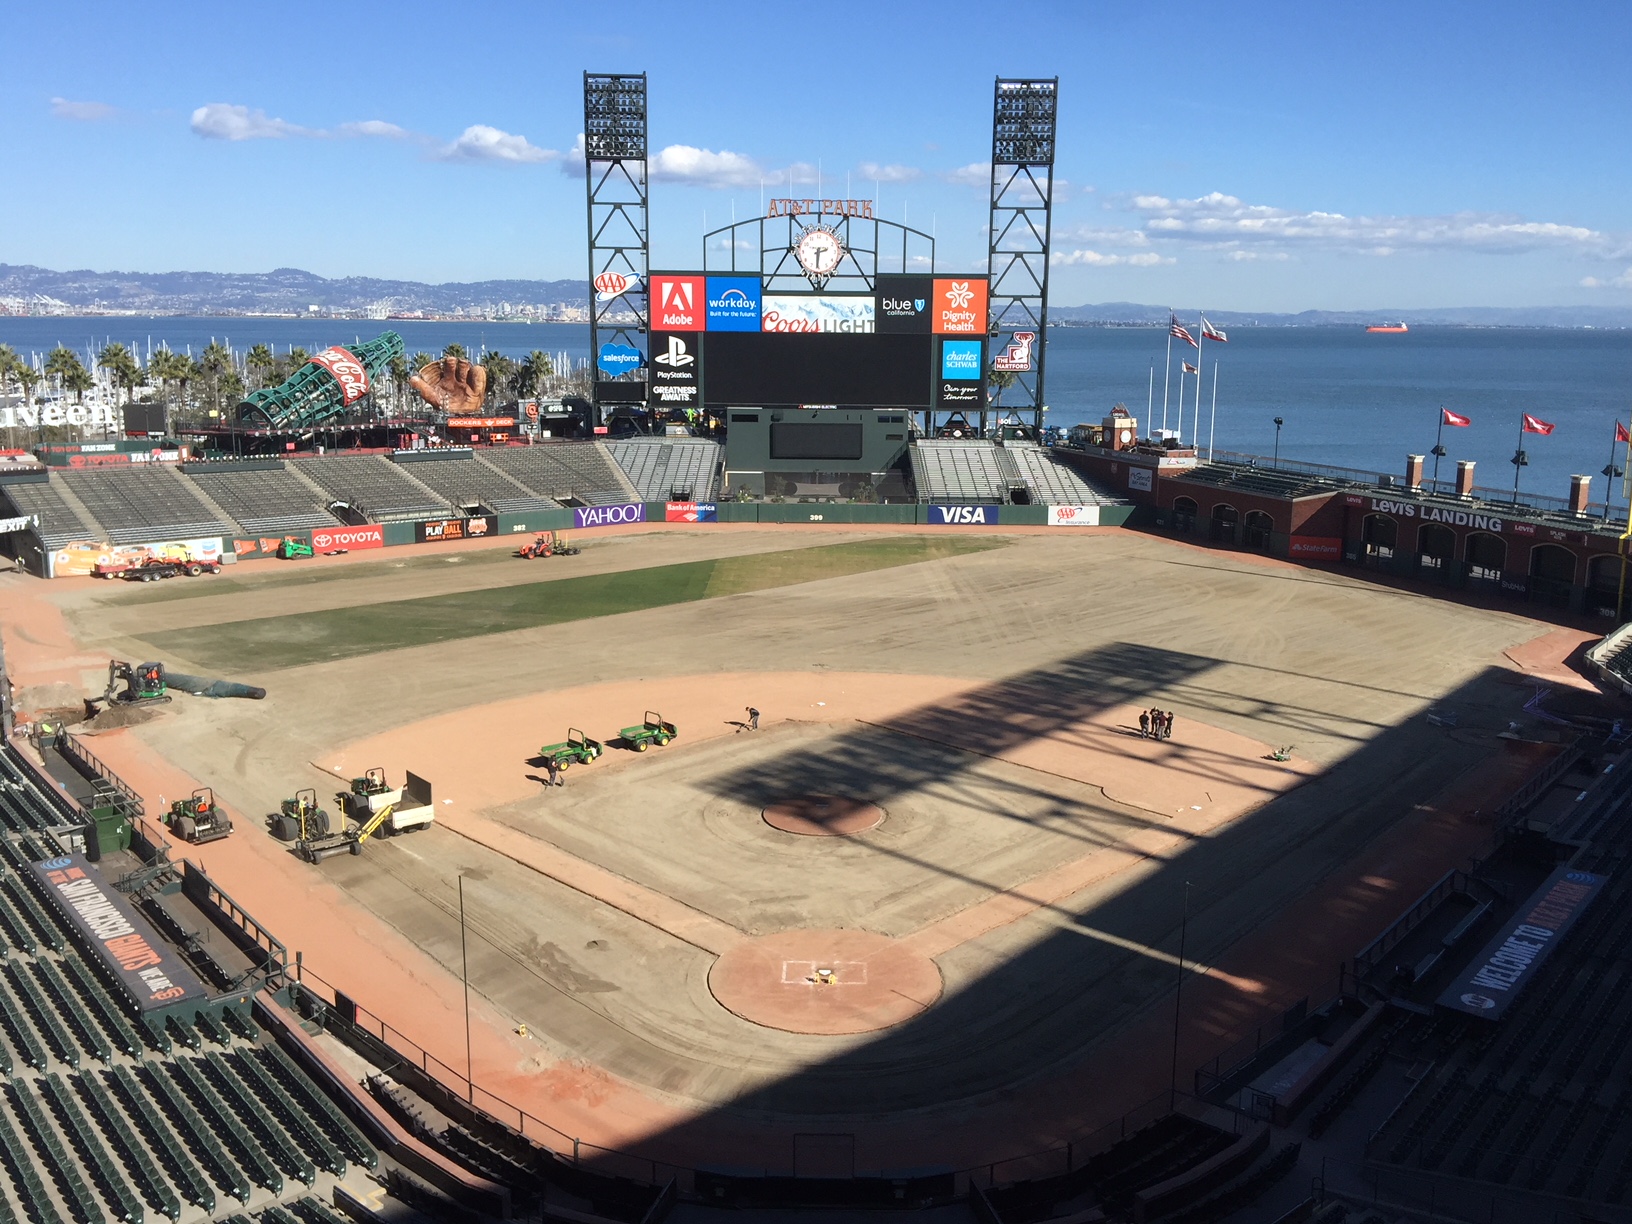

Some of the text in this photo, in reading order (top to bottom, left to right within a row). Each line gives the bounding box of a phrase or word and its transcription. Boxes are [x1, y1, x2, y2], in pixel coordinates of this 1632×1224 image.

[767, 198, 873, 220] AT&T PARK
[800, 268, 839, 281] GIANTS
[596, 273, 626, 293] AAA
[883, 298, 911, 310] blue
[663, 314, 693, 325] Adobe
[762, 311, 875, 333] Coors LIGHT
[942, 311, 976, 322] Dignity
[603, 354, 639, 364] salesforce
[946, 351, 977, 361] charles
[653, 386, 697, 394] GREATNESS
[86, 455, 129, 464] TOYOTA
[682, 503, 689, 511] of
[690, 504, 715, 512] America
[1058, 508, 1075, 519] AAA
[578, 504, 642, 527] YAHOO!
[938, 507, 985, 525] VISA
[1420, 507, 1502, 532] LANDING
[425, 525, 442, 536] PLAY
[444, 524, 461, 534] BALL
[333, 531, 381, 544] TOYOTA
[1501, 581, 1526, 592] StubHub
[57, 878, 100, 899] SAN
[69, 892, 135, 940] FRANCISCO
[104, 934, 162, 971] GIANTS
[1469, 935, 1544, 991] WELCOME
[1513, 924, 1554, 941] TO
[138, 966, 164, 981] WE
[145, 976, 174, 993] ARE
